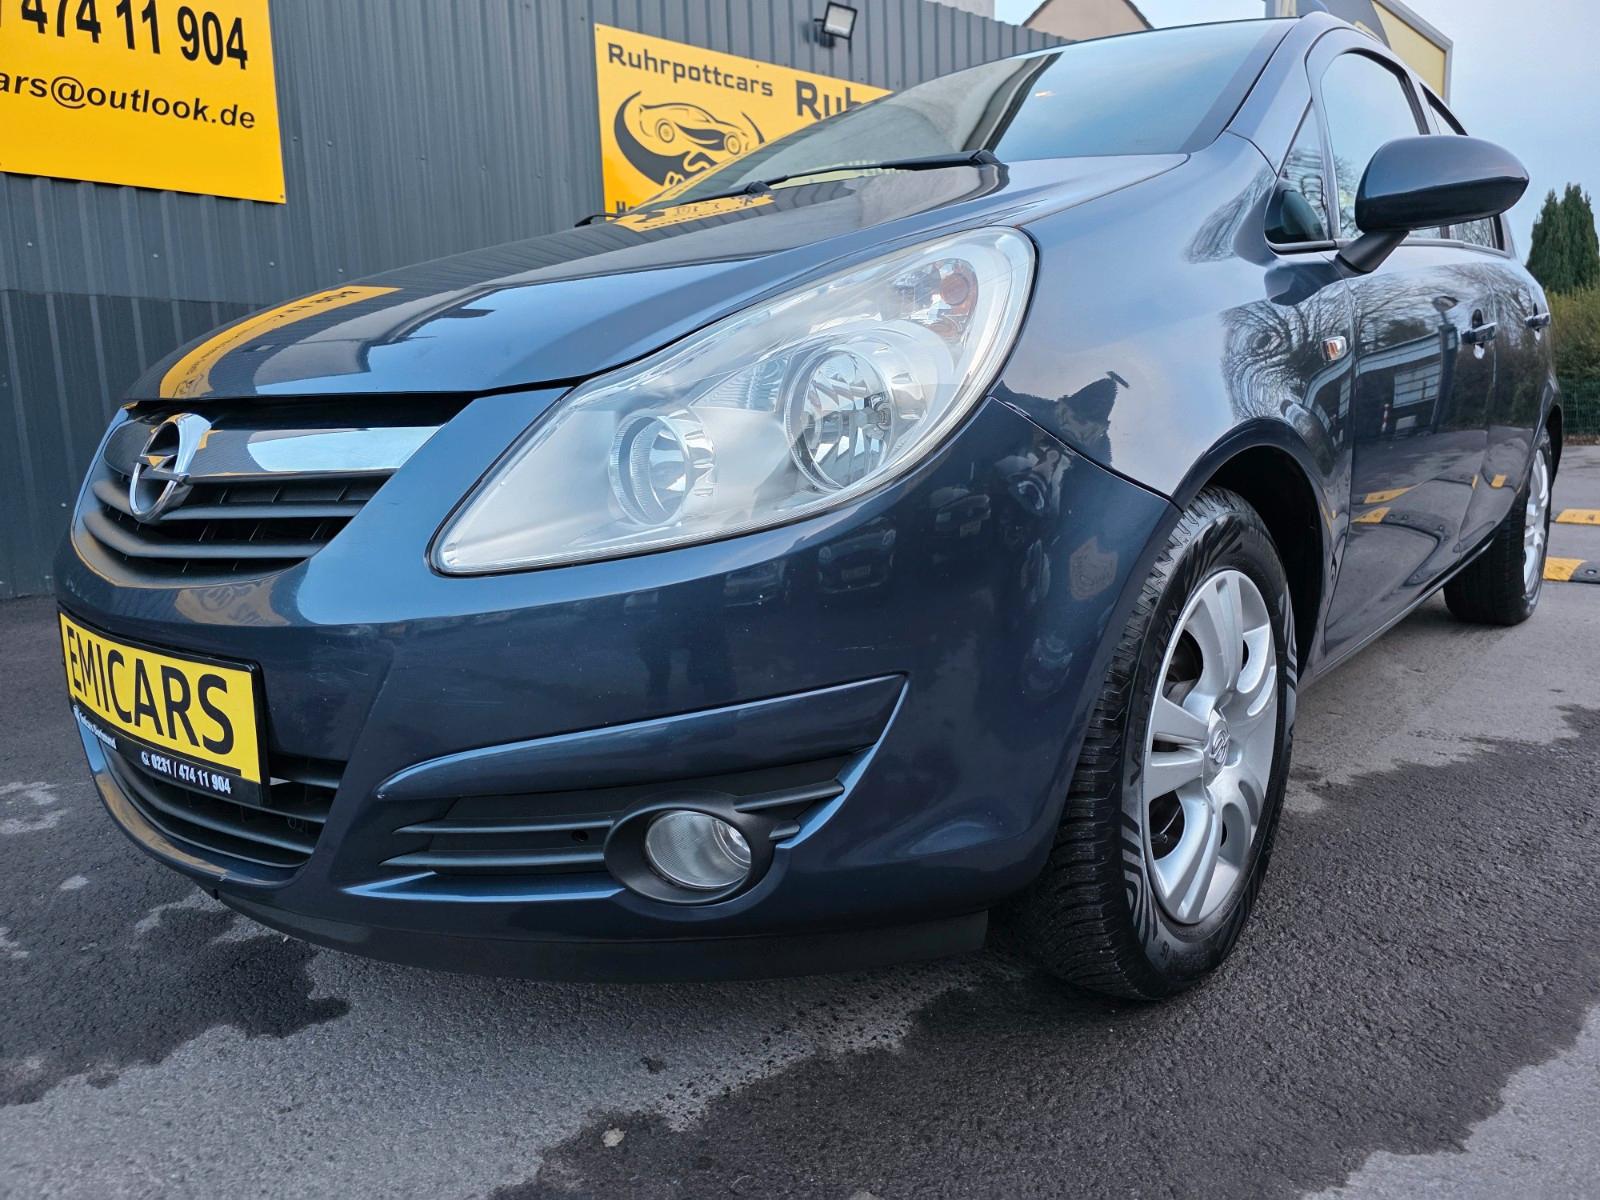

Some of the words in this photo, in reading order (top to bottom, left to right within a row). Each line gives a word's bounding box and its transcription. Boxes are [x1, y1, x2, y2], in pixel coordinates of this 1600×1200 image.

[21, 0, 102, 44] 474
[116, 0, 161, 54] 11
[177, 6, 248, 70] 904
[607, 42, 774, 97] Ruhrpottcars
[0, 72, 255, 129] ars@outlook.de
[66, 624, 235, 756] EMICARS
[151, 754, 172, 775] 0231
[179, 764, 196, 784] 474
[197, 769, 210, 788] 11
[211, 773, 232, 794] 904
